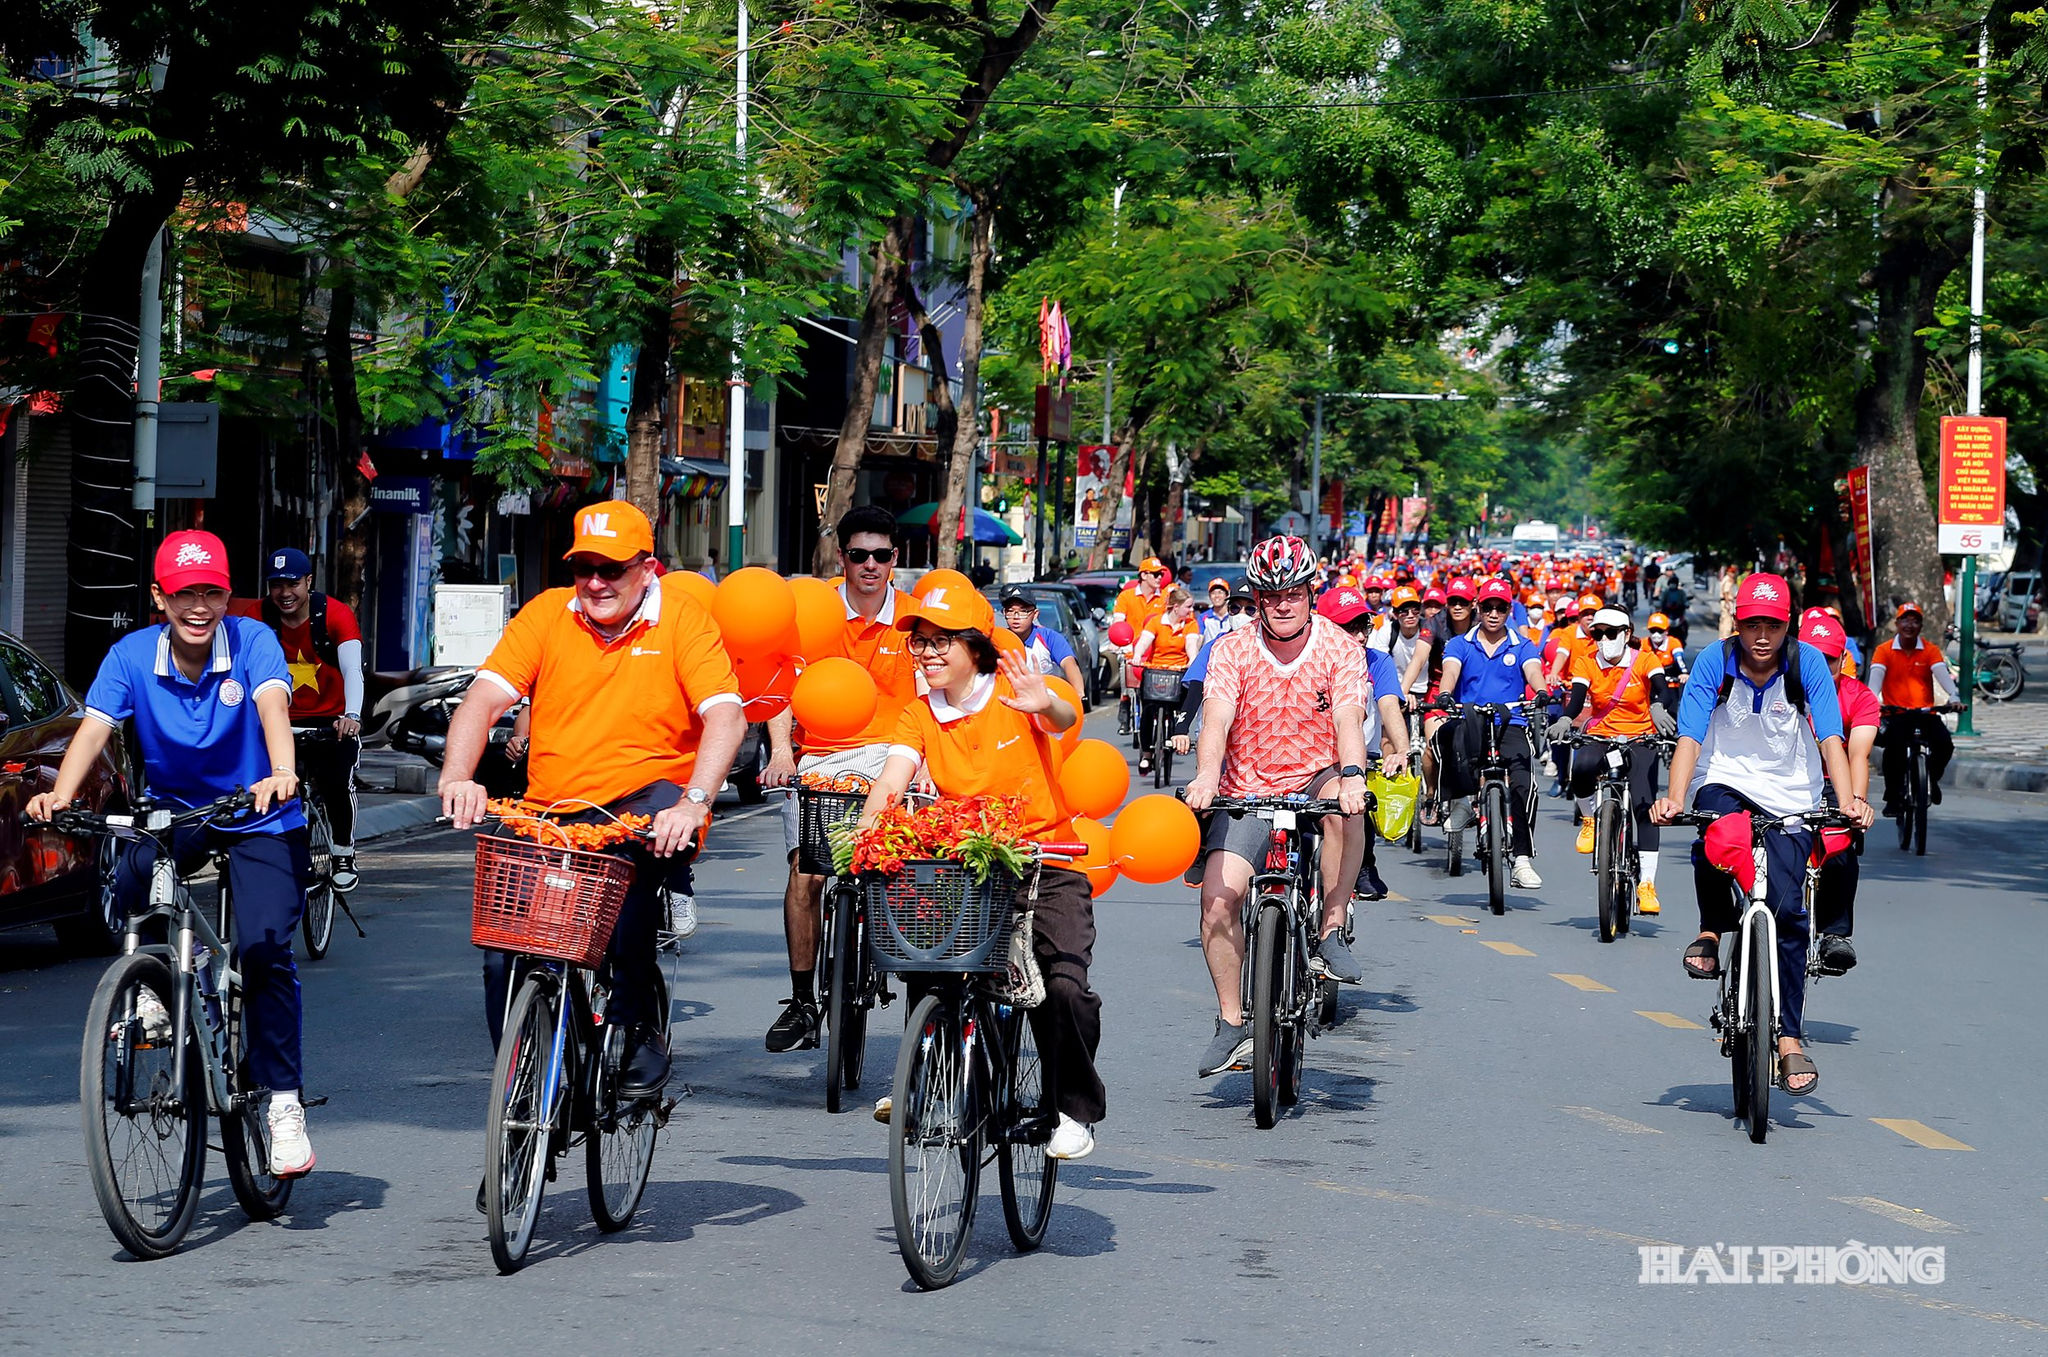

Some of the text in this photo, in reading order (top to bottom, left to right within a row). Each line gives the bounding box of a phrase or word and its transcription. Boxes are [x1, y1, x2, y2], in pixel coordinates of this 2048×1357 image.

[582, 512, 617, 537] NL
[1960, 534, 1982, 548] 5G
[921, 587, 950, 610] NL
